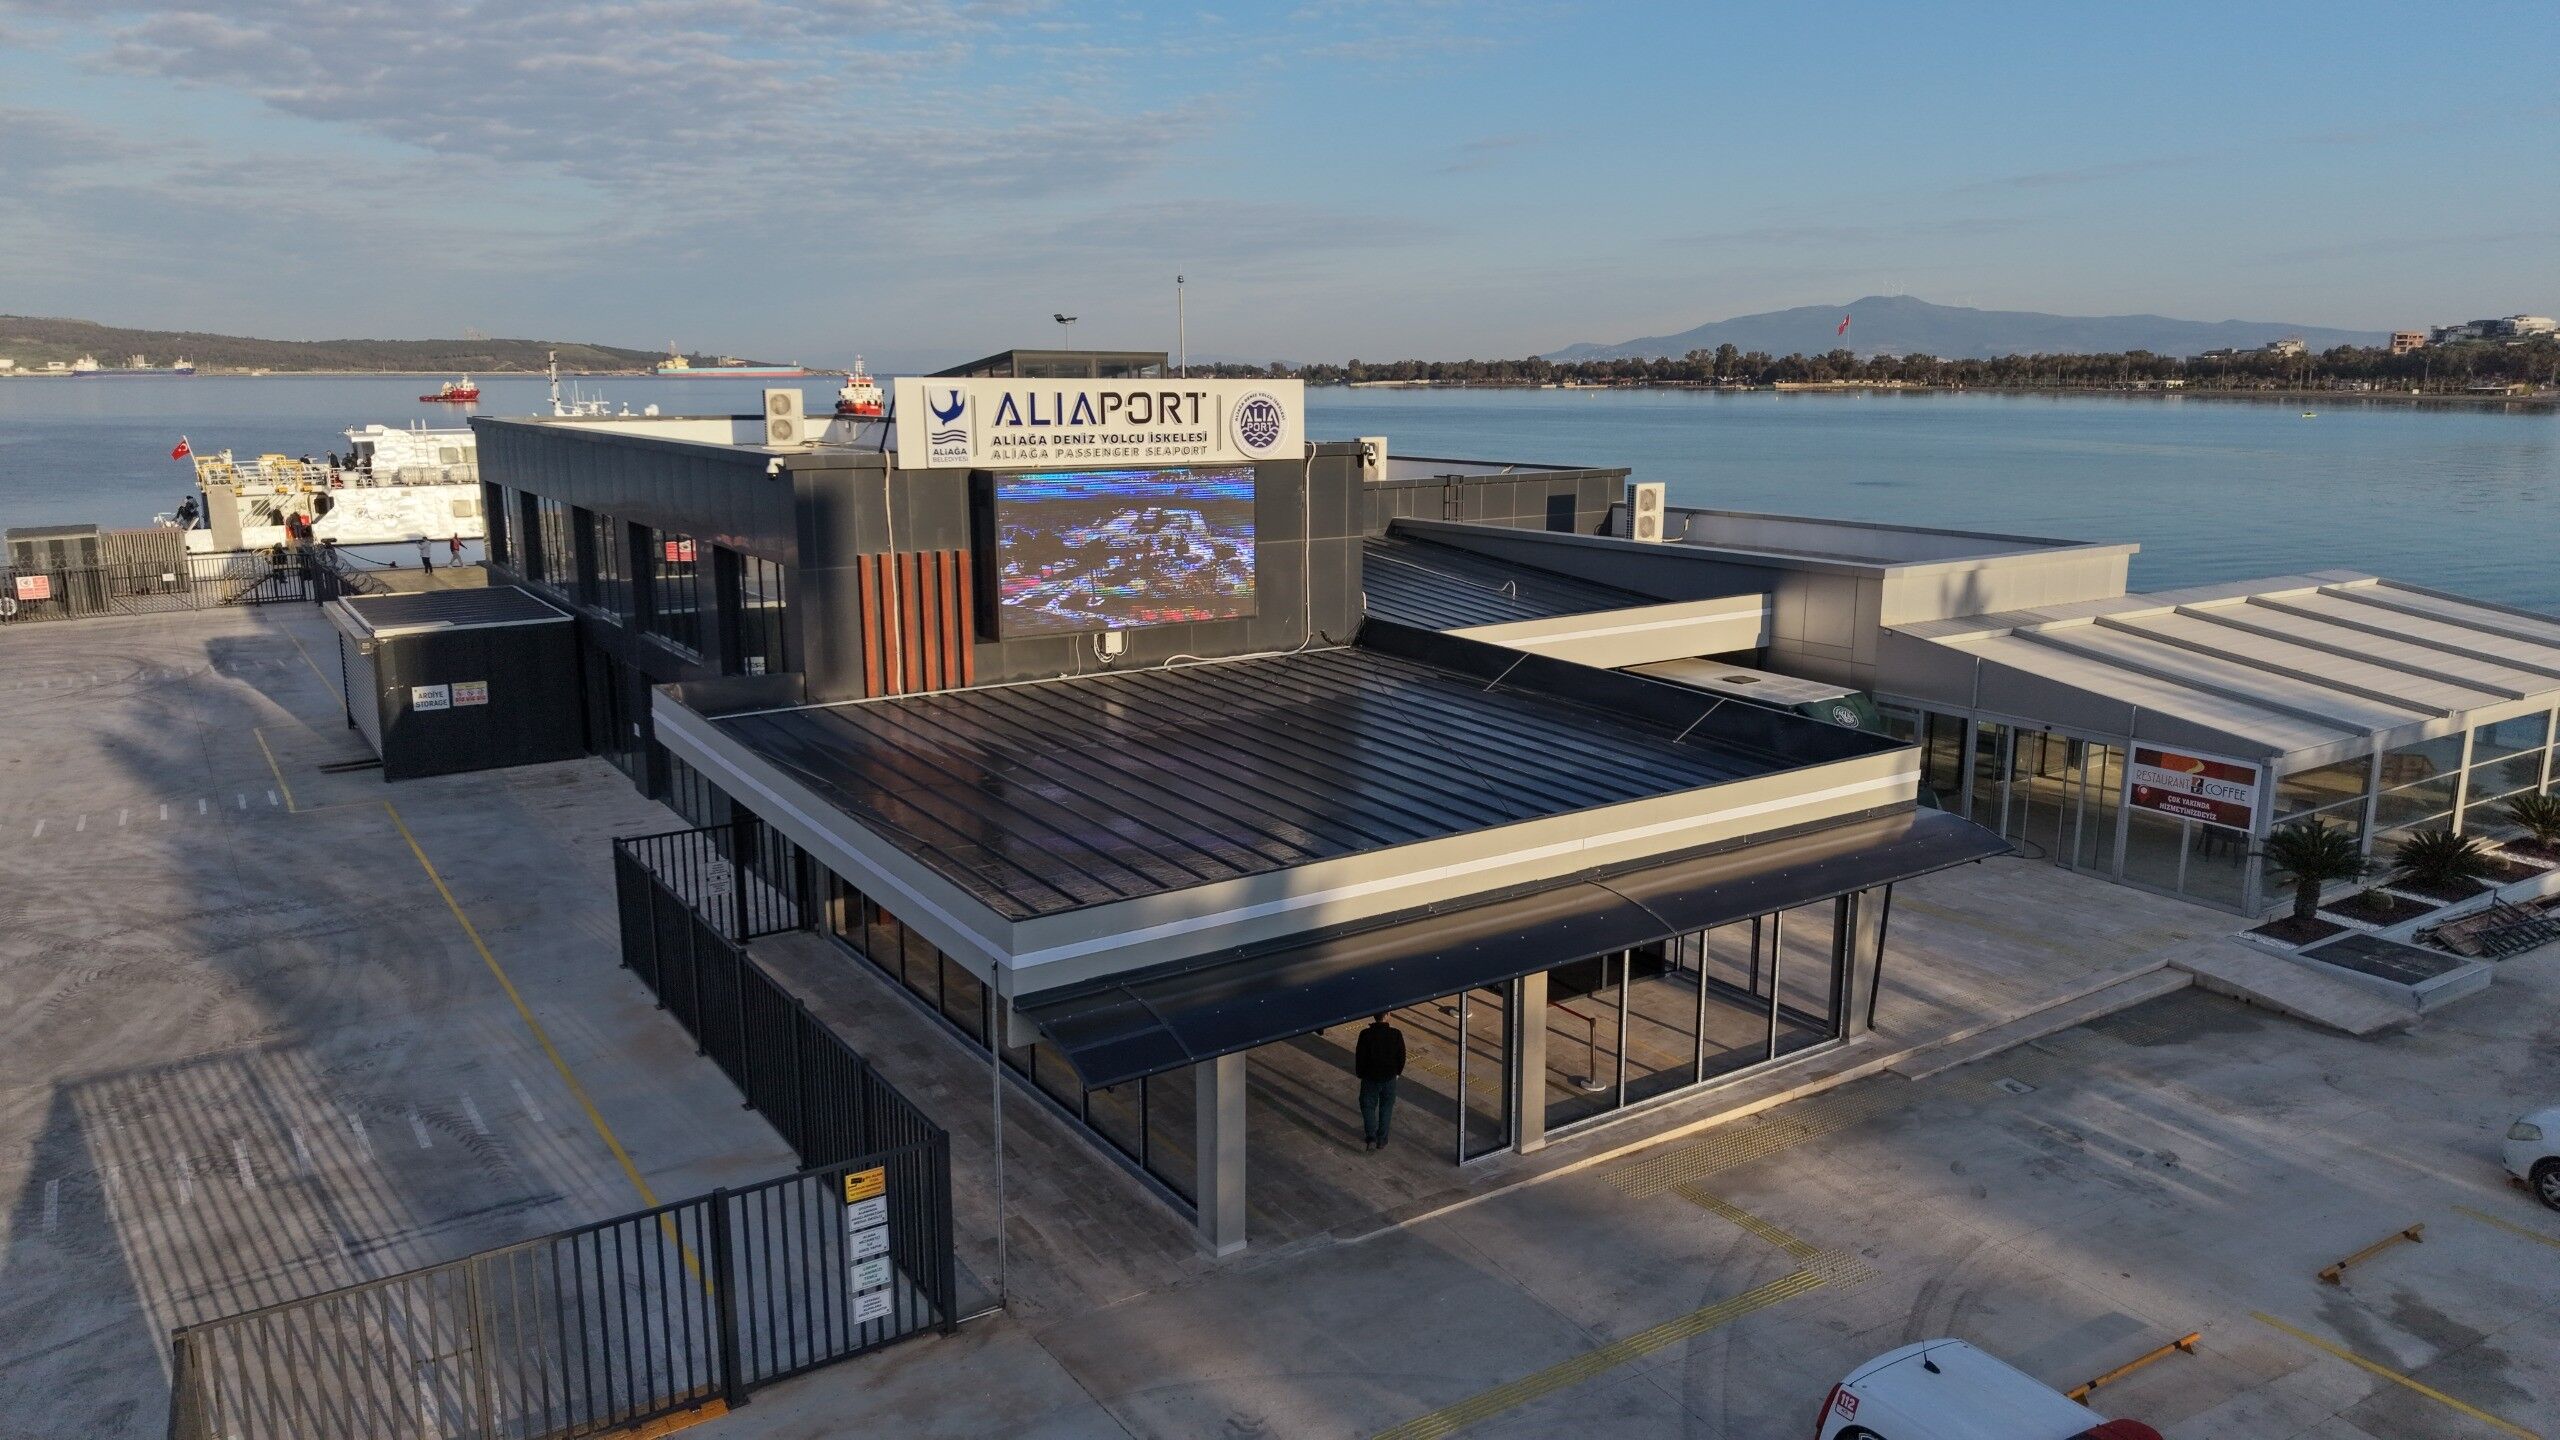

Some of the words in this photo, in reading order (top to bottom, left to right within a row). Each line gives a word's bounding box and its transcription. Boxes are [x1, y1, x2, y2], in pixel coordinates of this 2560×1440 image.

[993, 391, 1206, 427] ALIAPORT
[1241, 408, 1279, 427] ALIA
[1247, 422, 1273, 431] PORT
[992, 434, 1047, 446] ALİAĞA
[1054, 433, 1095, 445] DENİZ
[1101, 433, 1145, 444] YOLCU
[1150, 431, 1208, 443] İSKELESİ
[1055, 447, 1139, 459] PASSENGER
[1146, 445, 1208, 456] SEAPORT
[415, 699, 448, 708] STORAGE
[2136, 770, 2191, 790] RESTAURANT
[2205, 783, 2246, 802] COFFEE
[2182, 798, 2210, 810] YAKINDA
[1841, 1393, 1856, 1411] 112
